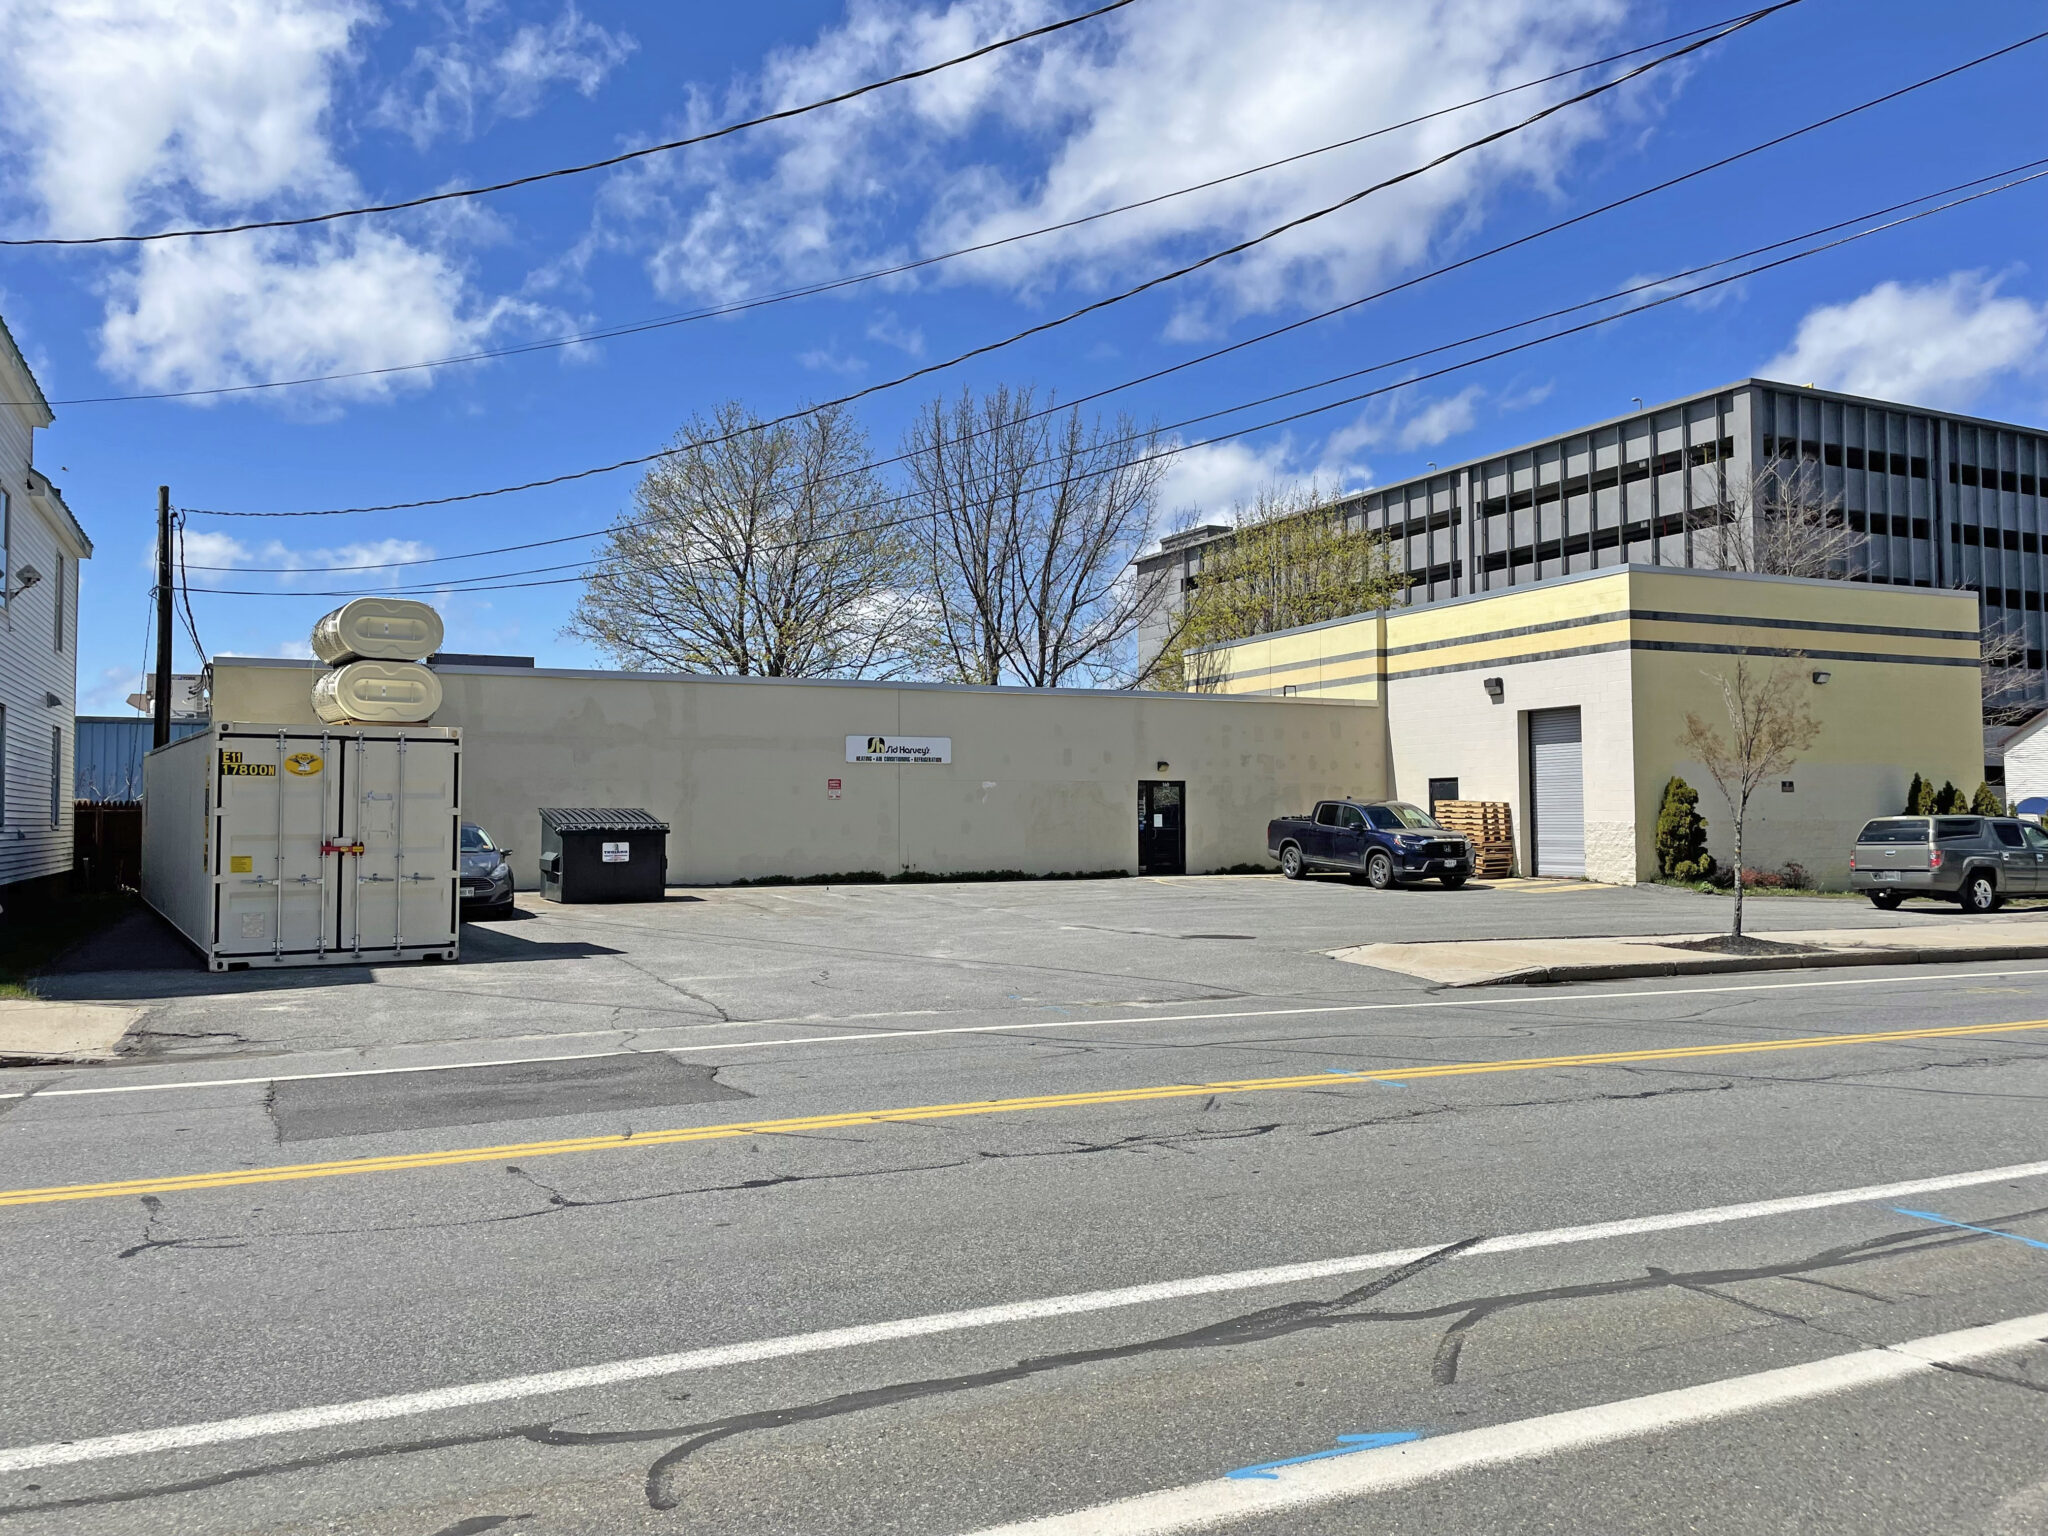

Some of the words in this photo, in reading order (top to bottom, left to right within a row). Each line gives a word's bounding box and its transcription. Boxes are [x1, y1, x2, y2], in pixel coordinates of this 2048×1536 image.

[885, 745, 898, 754] Sid
[899, 745, 930, 756] Harvey's
[222, 752, 242, 763] E11
[222, 764, 276, 776] 17800N
